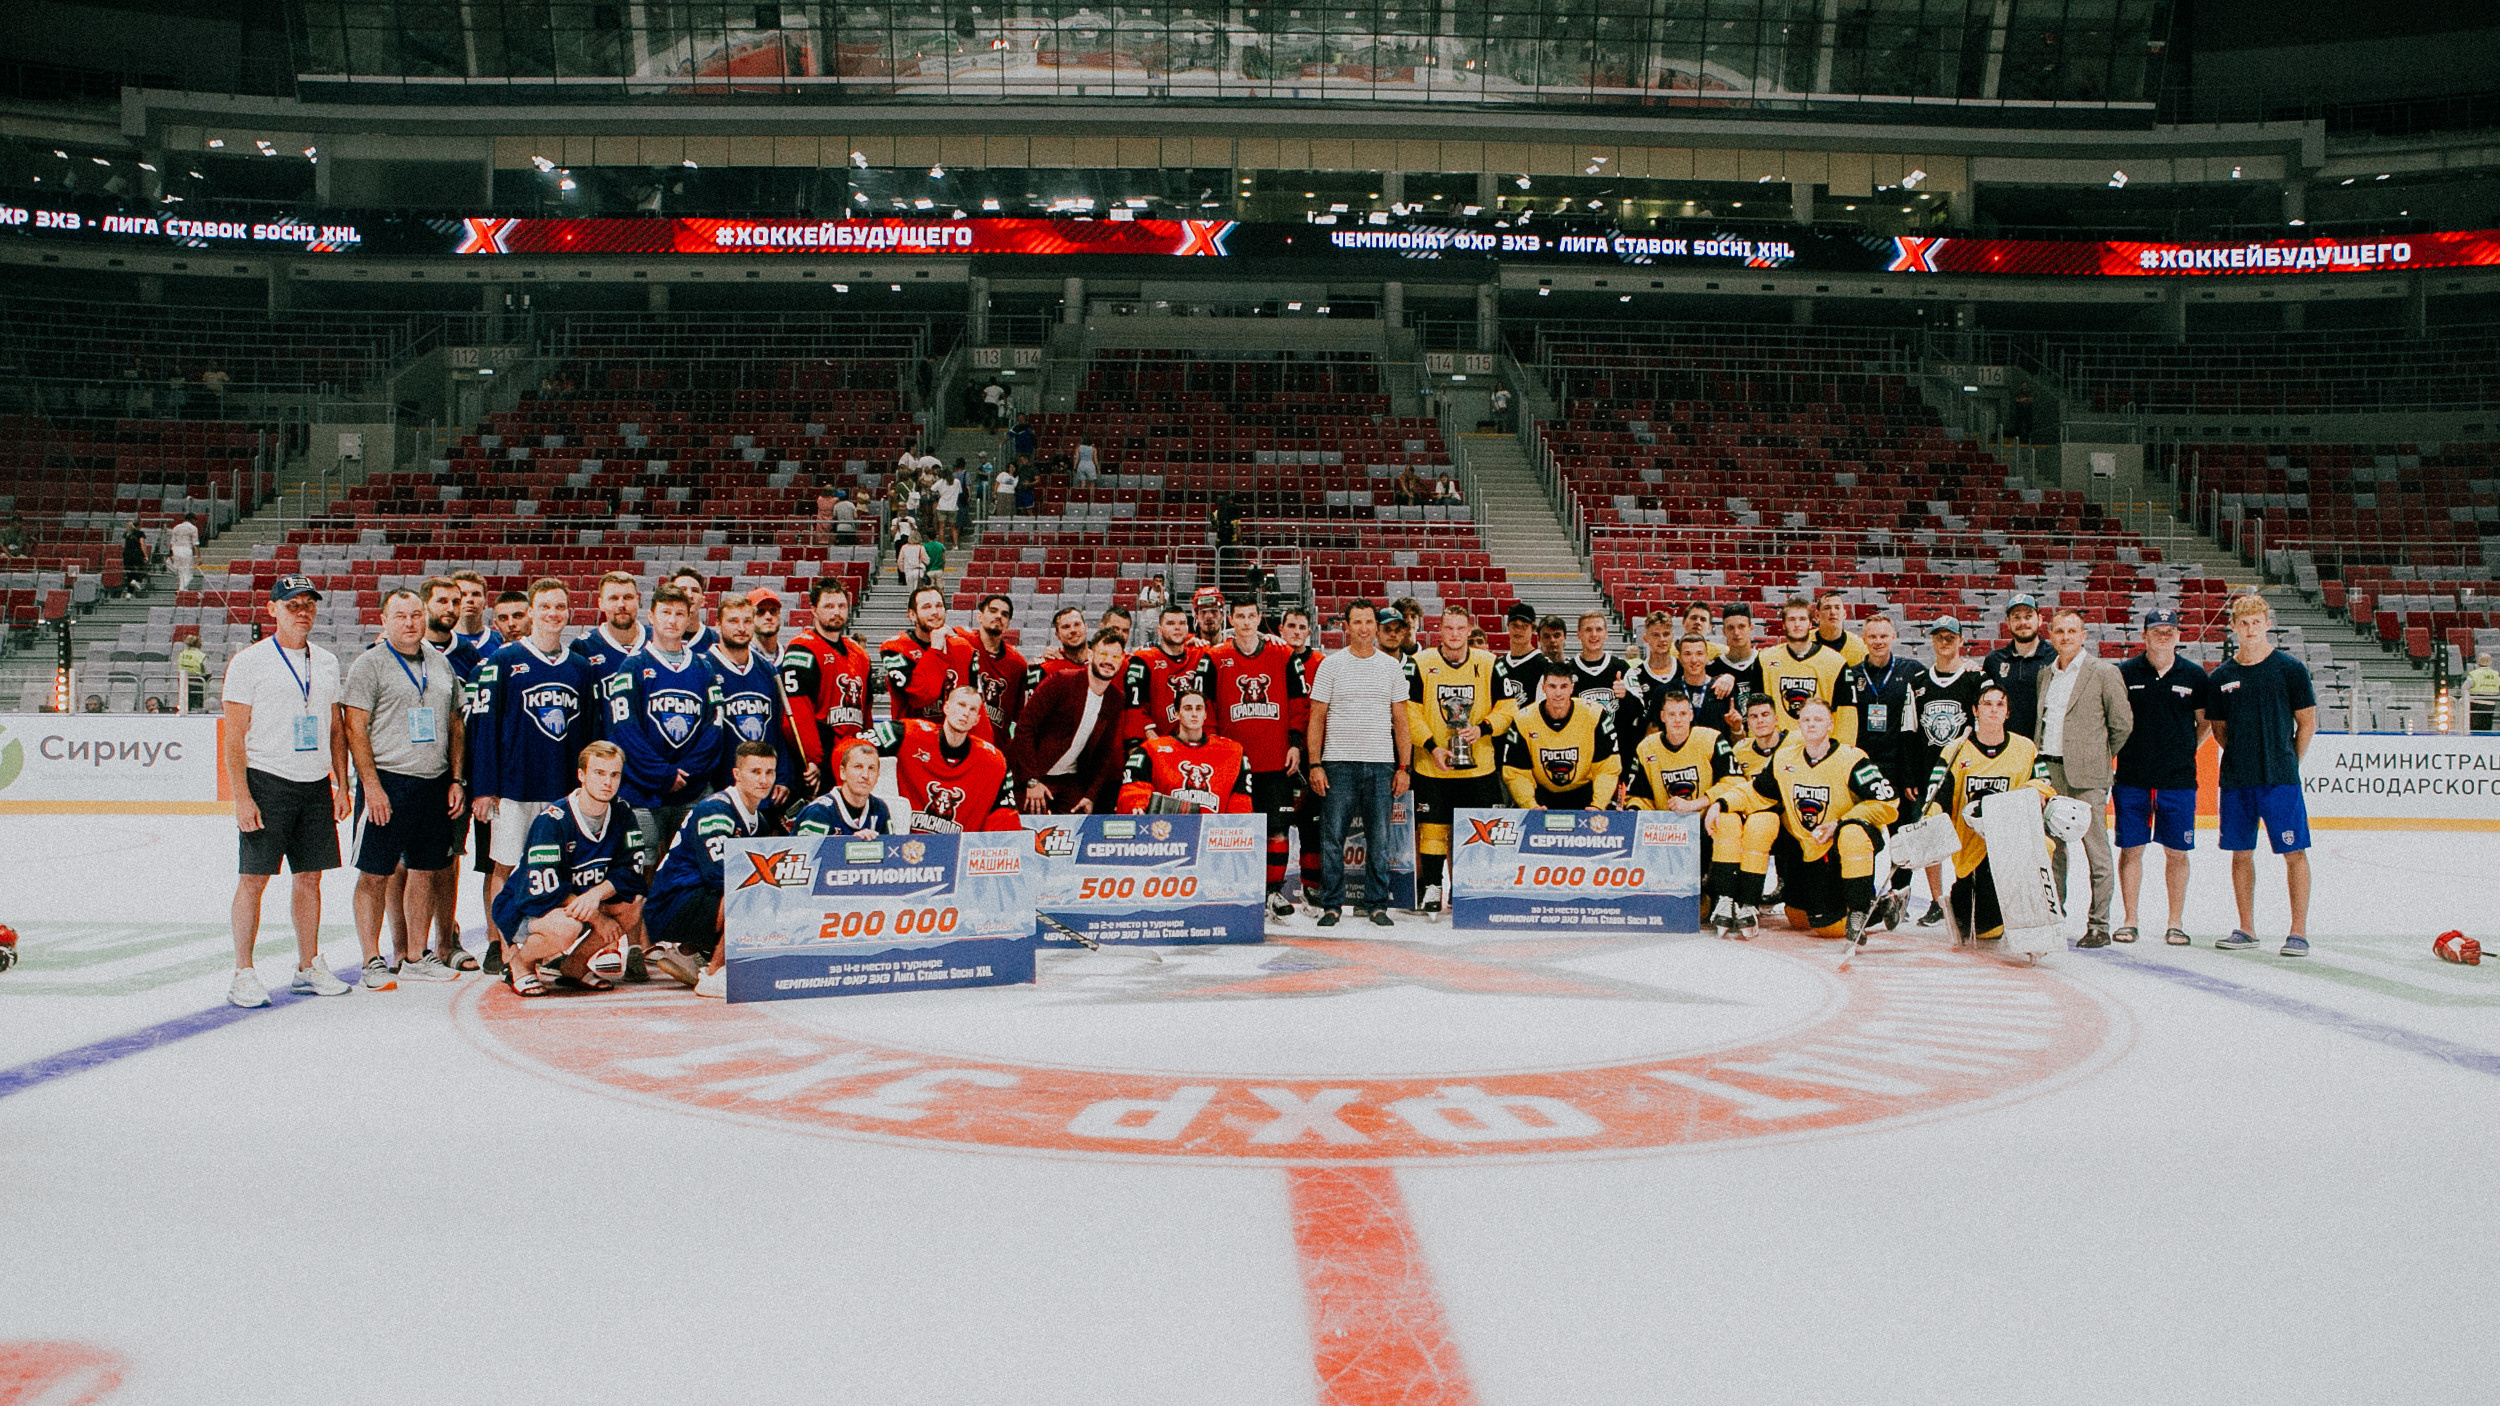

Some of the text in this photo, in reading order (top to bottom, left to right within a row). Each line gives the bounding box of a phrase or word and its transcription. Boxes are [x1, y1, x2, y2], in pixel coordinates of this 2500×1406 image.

[103, 215, 159, 235] ЛИГА
[165, 219, 247, 239] СТАВОК
[253, 223, 315, 241] SOCHI
[321, 225, 361, 242] XHL
[715, 224, 972, 249] #ХОККЕЙБУДУЩЕГО
[1332, 231, 1449, 250] ЧЕМПИОНАТ
[1453, 234, 1497, 251] ФХР
[1559, 236, 1608, 254] ЛИГА
[1614, 238, 1688, 255] СТАВОК
[1693, 240, 1751, 258] SOCHI
[1757, 243, 1795, 258] XHL
[2140, 243, 2411, 270] #ХОККЕЙБУДУЩЕГО
[455, 350, 477, 363] 112
[975, 350, 999, 364] 113
[1016, 351, 1039, 365] 114
[1428, 356, 1451, 369] 114
[1467, 357, 1491, 370] 115
[1980, 368, 2002, 381] 116
[784, 670, 799, 693] 5
[1781, 678, 1816, 690] РОСТОВ
[528, 690, 578, 710] КРЫМ
[1438, 685, 1474, 698] РОСТОВ
[611, 696, 630, 724] 18
[651, 696, 700, 716] КРЫМ
[726, 700, 769, 717] КРЫМ
[1232, 703, 1277, 720] КРАСНОДАР
[1927, 702, 1955, 714] СОЧИ
[40, 735, 183, 767] Сириус
[1541, 749, 1577, 763] РОСТОВ
[1662, 767, 1698, 784] РОСТОВ
[1967, 776, 2009, 792] РОСТОВ
[1793, 786, 1829, 800] РОСТОВ
[1870, 780, 1894, 800] 36
[2304, 777, 2500, 797] КРАСНОДАРСКОГО
[1461, 817, 1521, 847] XHL
[1905, 820, 1929, 833] CCM
[1208, 837, 1253, 848] МАШИНА
[1529, 835, 1624, 849] СЕРТИФИКАТ
[1643, 832, 1688, 842] МАШИНА
[705, 834, 724, 862] 2
[1087, 842, 1188, 857] СЕРТИФИКАТ
[735, 848, 812, 891] XHL
[968, 858, 1020, 871] МАШИНА
[528, 867, 560, 896] 30
[572, 866, 608, 887] КРЫ
[825, 866, 946, 887] СЕРТИФИКАТ
[1514, 866, 1646, 887] 1 000 000
[1079, 876, 1199, 899] 500 000
[2039, 866, 2058, 916] CCM
[819, 907, 959, 939] 200 000
[1489, 914, 1541, 924] ЧЕМПИОНАТ
[844, 963, 860, 973] 4-е
[862, 961, 892, 972] место
[893, 961, 900, 970] в
[901, 959, 943, 972] турнире
[775, 976, 842, 990] ЧЕМПИОНАТ
[843, 974, 868, 986] ФХР
